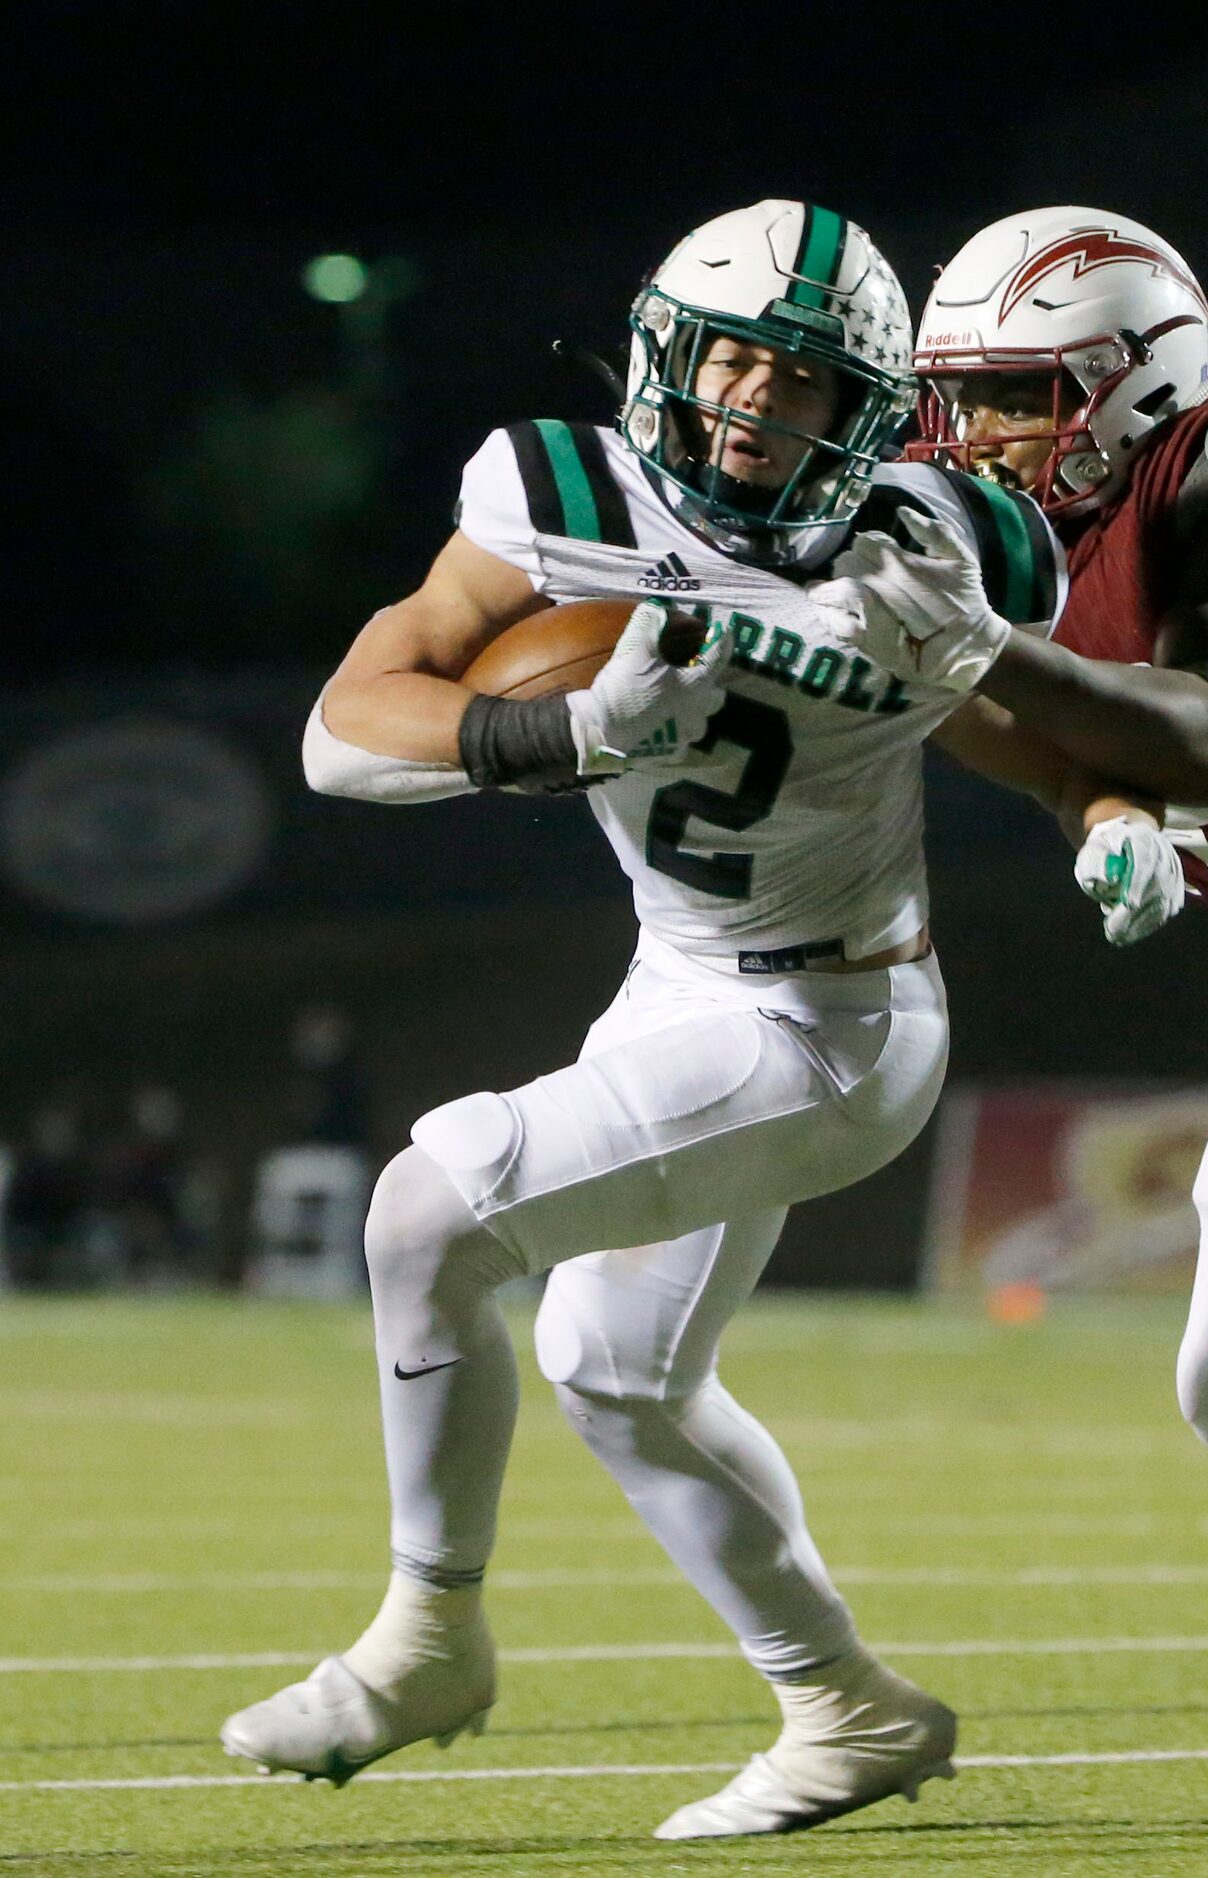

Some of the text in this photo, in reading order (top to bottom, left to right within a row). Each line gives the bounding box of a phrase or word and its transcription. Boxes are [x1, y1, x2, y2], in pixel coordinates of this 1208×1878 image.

[926, 332, 972, 347] Riddell
[637, 576, 701, 591] adidas
[645, 691, 795, 900] 2
